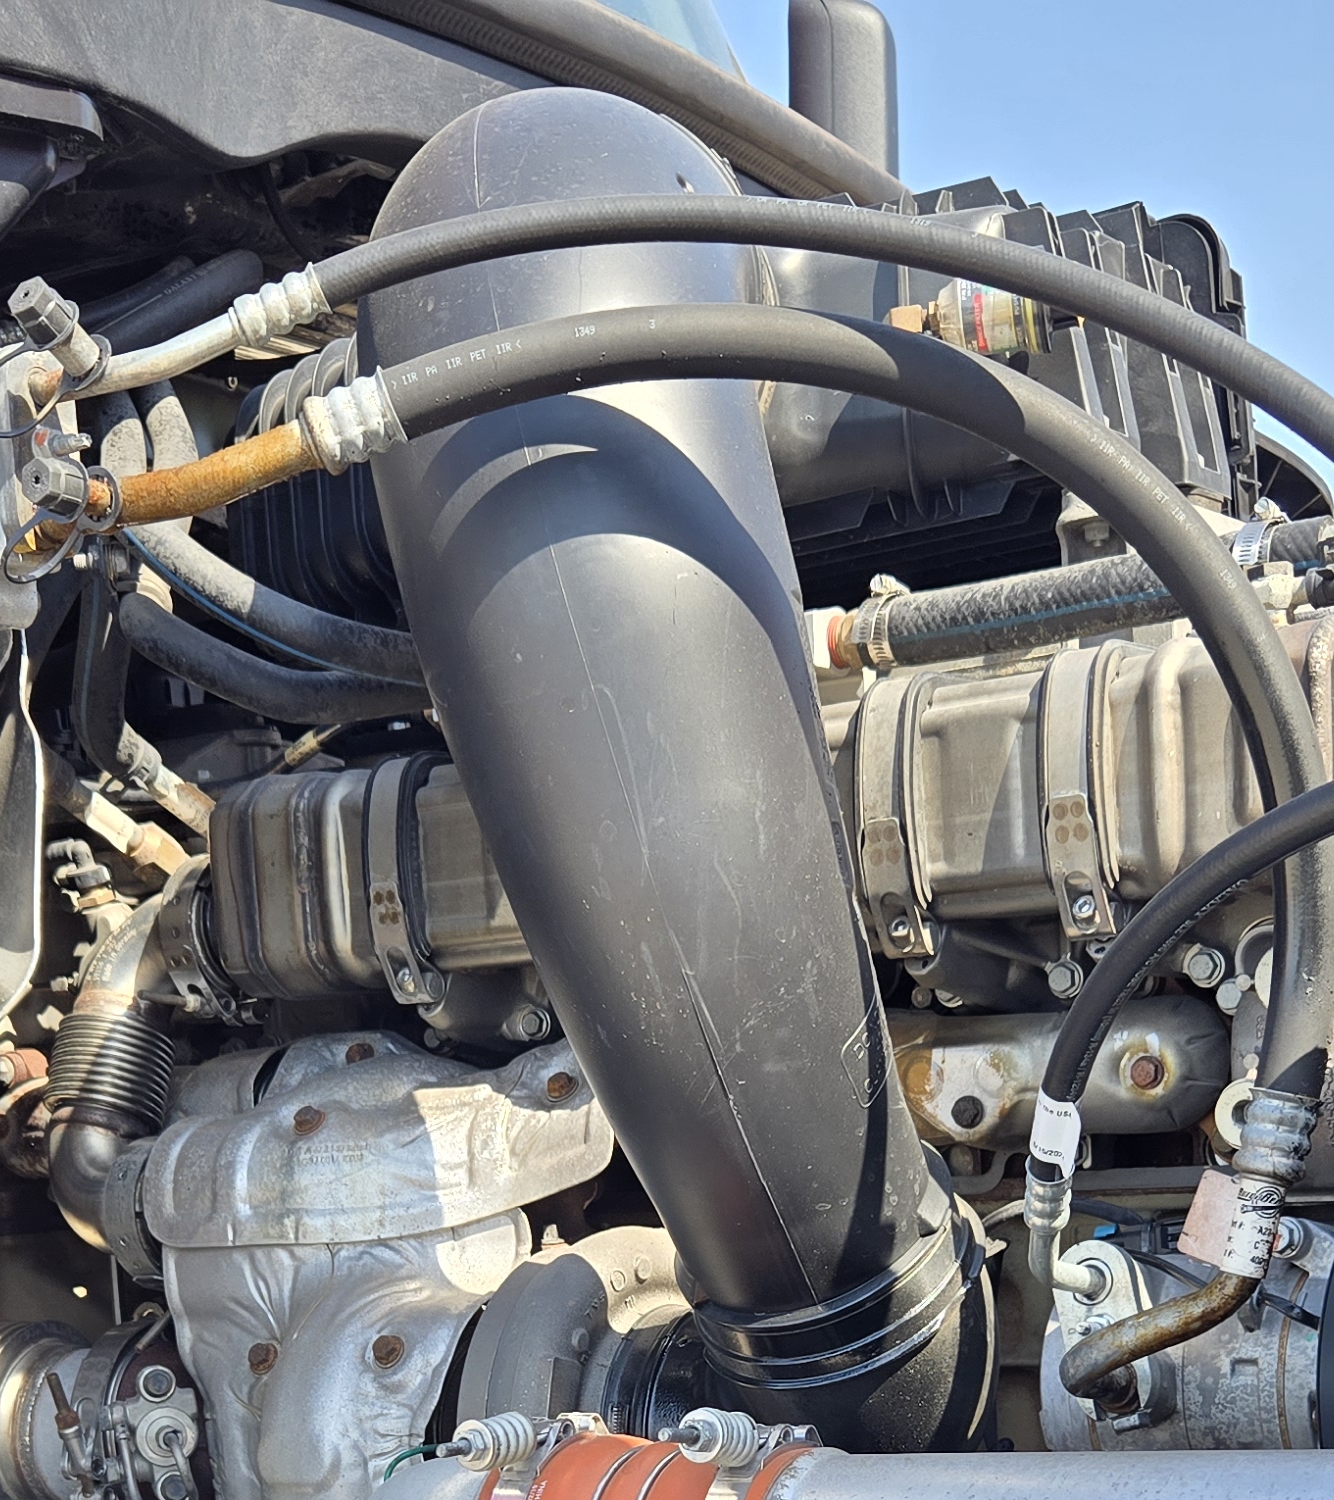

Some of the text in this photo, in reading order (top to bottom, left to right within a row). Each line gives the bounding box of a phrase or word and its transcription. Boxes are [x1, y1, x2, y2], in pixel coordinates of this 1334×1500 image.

[573, 324, 596, 339] 1349
[401, 371, 419, 386] IIR
[425, 364, 438, 377] PA
[445, 356, 463, 370] IIR
[470, 348, 487, 363] PET
[495, 341, 513, 355] IIR
[1152, 487, 1170, 505] PET
